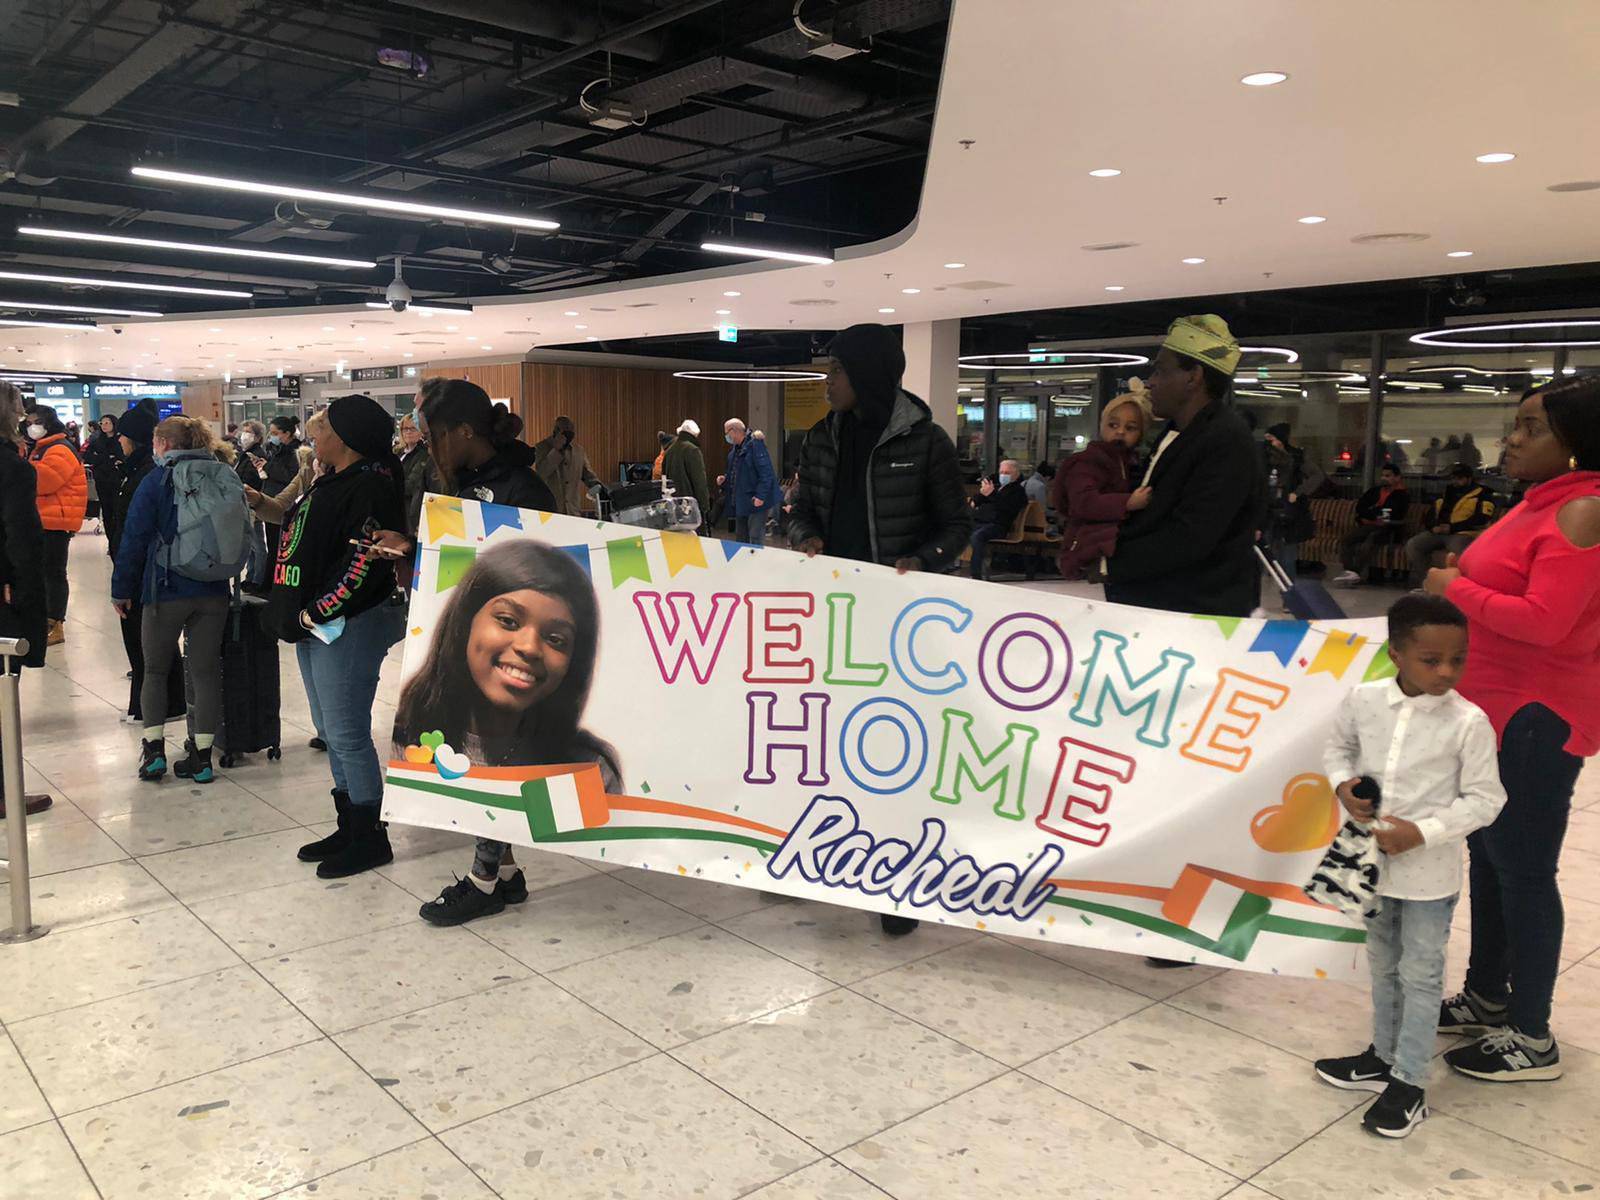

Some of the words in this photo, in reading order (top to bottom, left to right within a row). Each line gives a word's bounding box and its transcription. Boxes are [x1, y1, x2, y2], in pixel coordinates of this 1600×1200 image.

[632, 591, 1290, 773] WELCOME
[743, 691, 1137, 847] HOME
[767, 794, 1065, 922] Racheal
